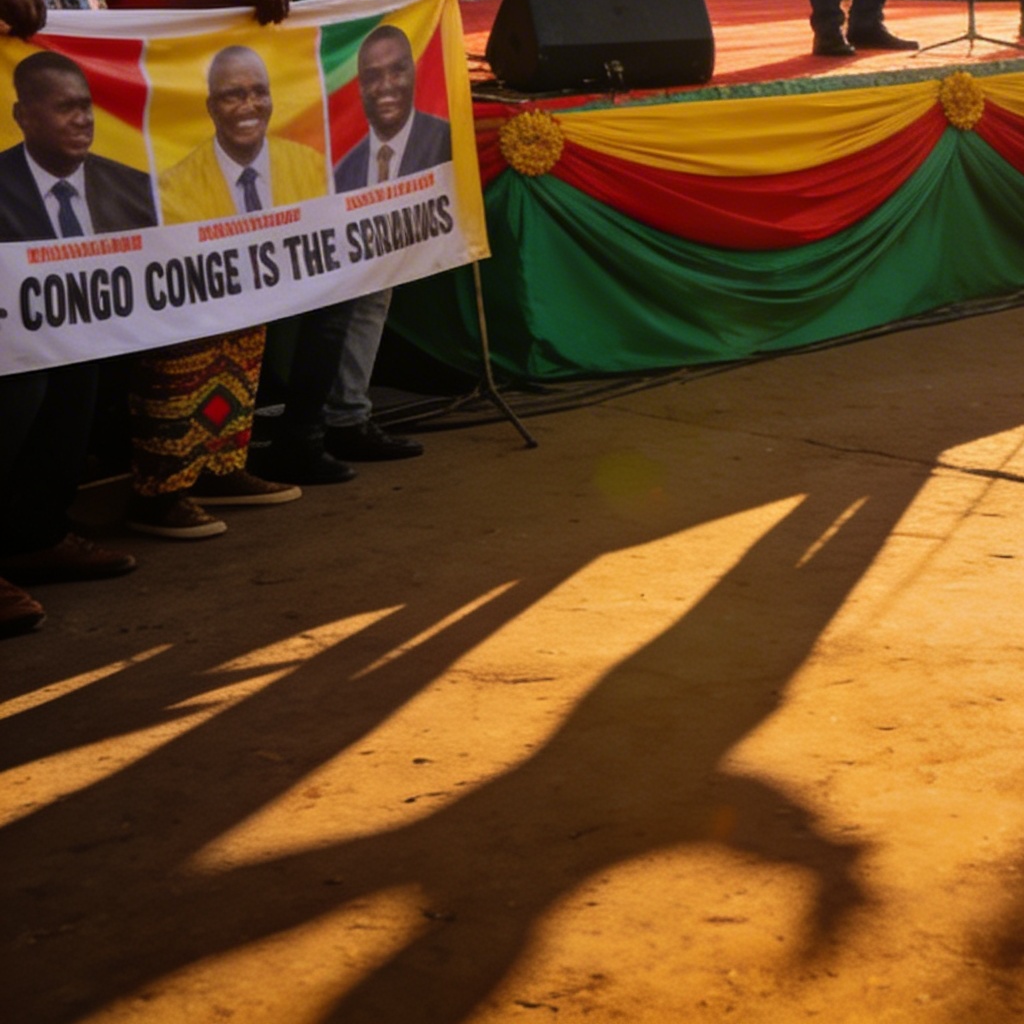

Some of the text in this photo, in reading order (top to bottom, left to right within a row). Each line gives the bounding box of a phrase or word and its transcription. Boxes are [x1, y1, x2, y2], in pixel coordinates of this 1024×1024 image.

[20, 266, 134, 332] CONGO
[145, 249, 242, 311] CONGE
[248, 241, 280, 290] IS
[283, 228, 341, 280] THE
